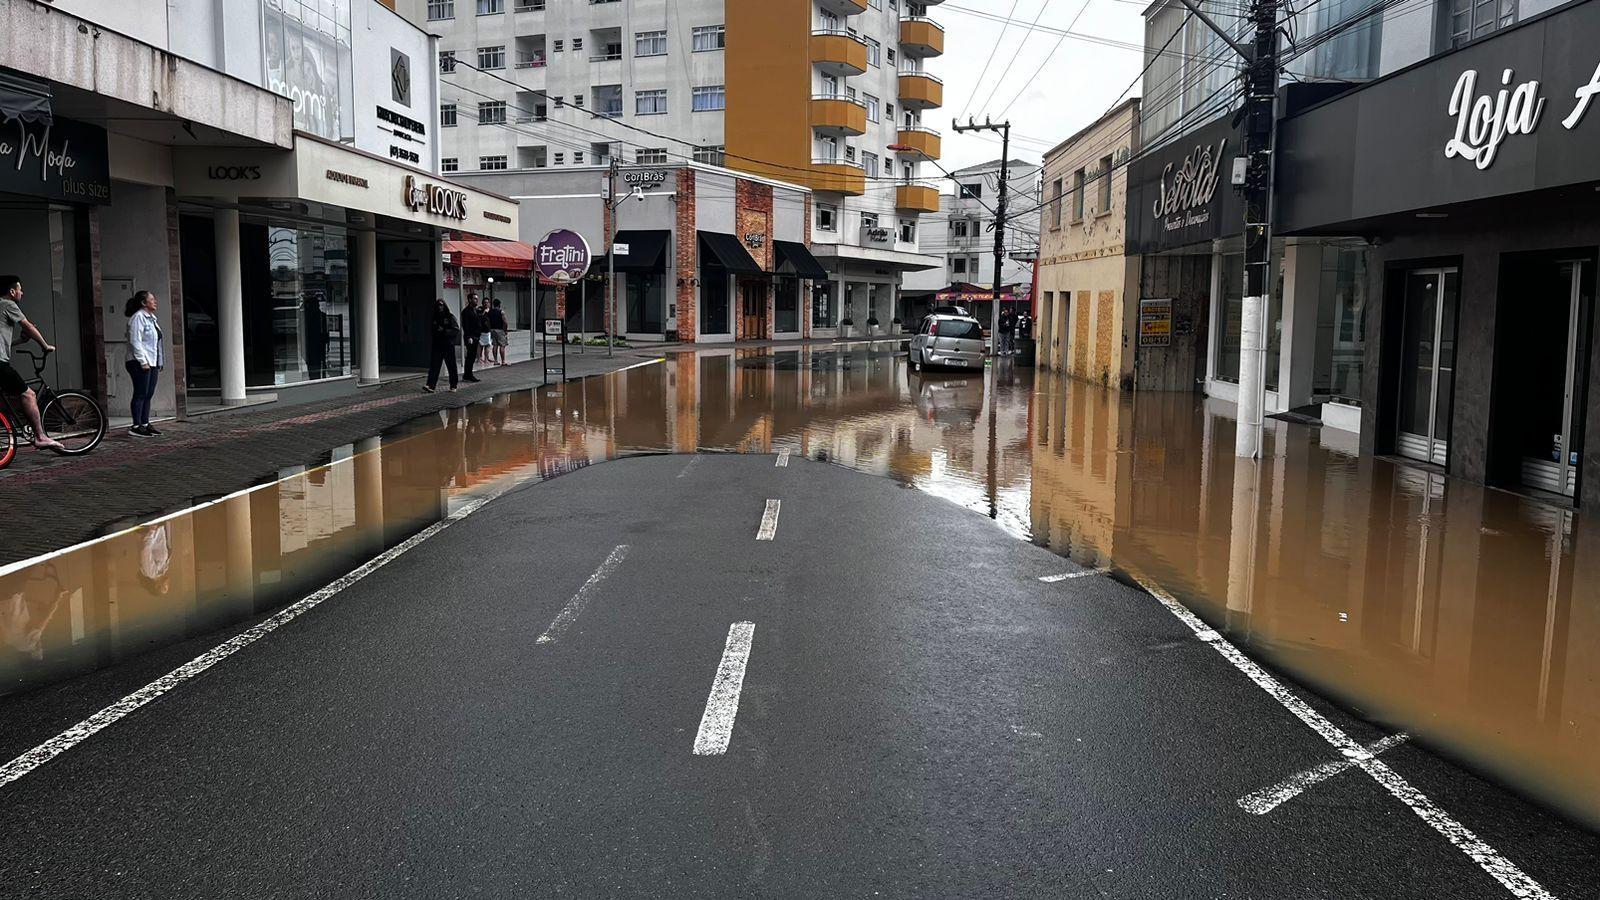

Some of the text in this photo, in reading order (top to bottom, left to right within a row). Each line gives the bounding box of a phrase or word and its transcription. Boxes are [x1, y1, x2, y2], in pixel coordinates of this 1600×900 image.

[1444, 68, 1546, 170] Loja
[16, 117, 76, 182] Moda
[63, 177, 109, 198] plus size
[208, 165, 262, 181] LOOK'S
[428, 184, 467, 221] LOOK'S
[540, 244, 585, 269] Fratini
